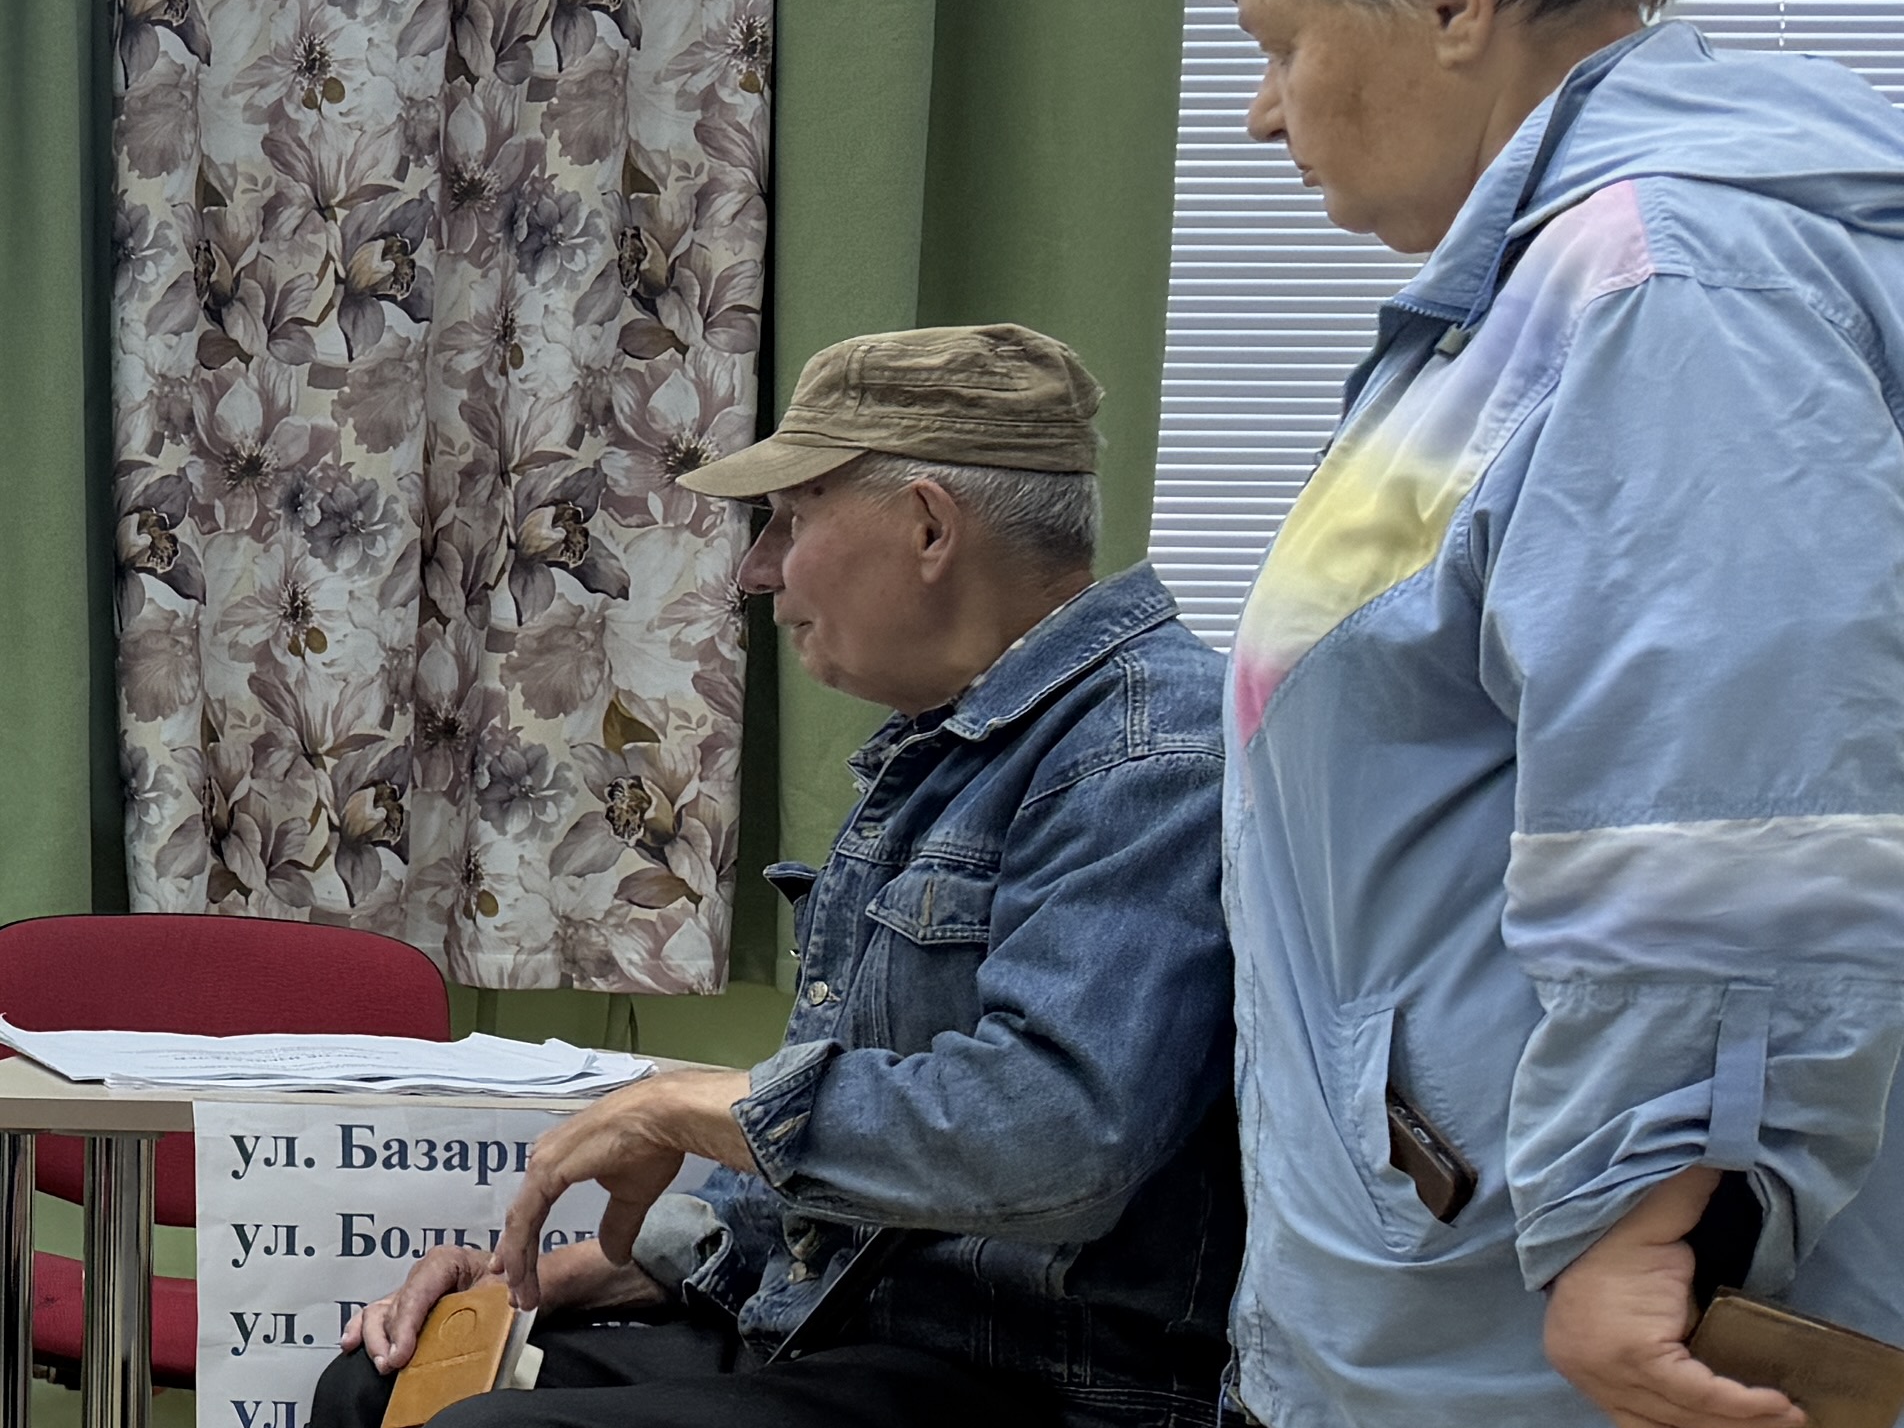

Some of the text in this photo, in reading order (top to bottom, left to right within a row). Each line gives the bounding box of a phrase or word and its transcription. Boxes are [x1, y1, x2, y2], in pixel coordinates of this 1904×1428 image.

[230, 1123, 536, 1186] ул. Базарн
[230, 1222, 316, 1269] ул.
[230, 1310, 315, 1356] ул.
